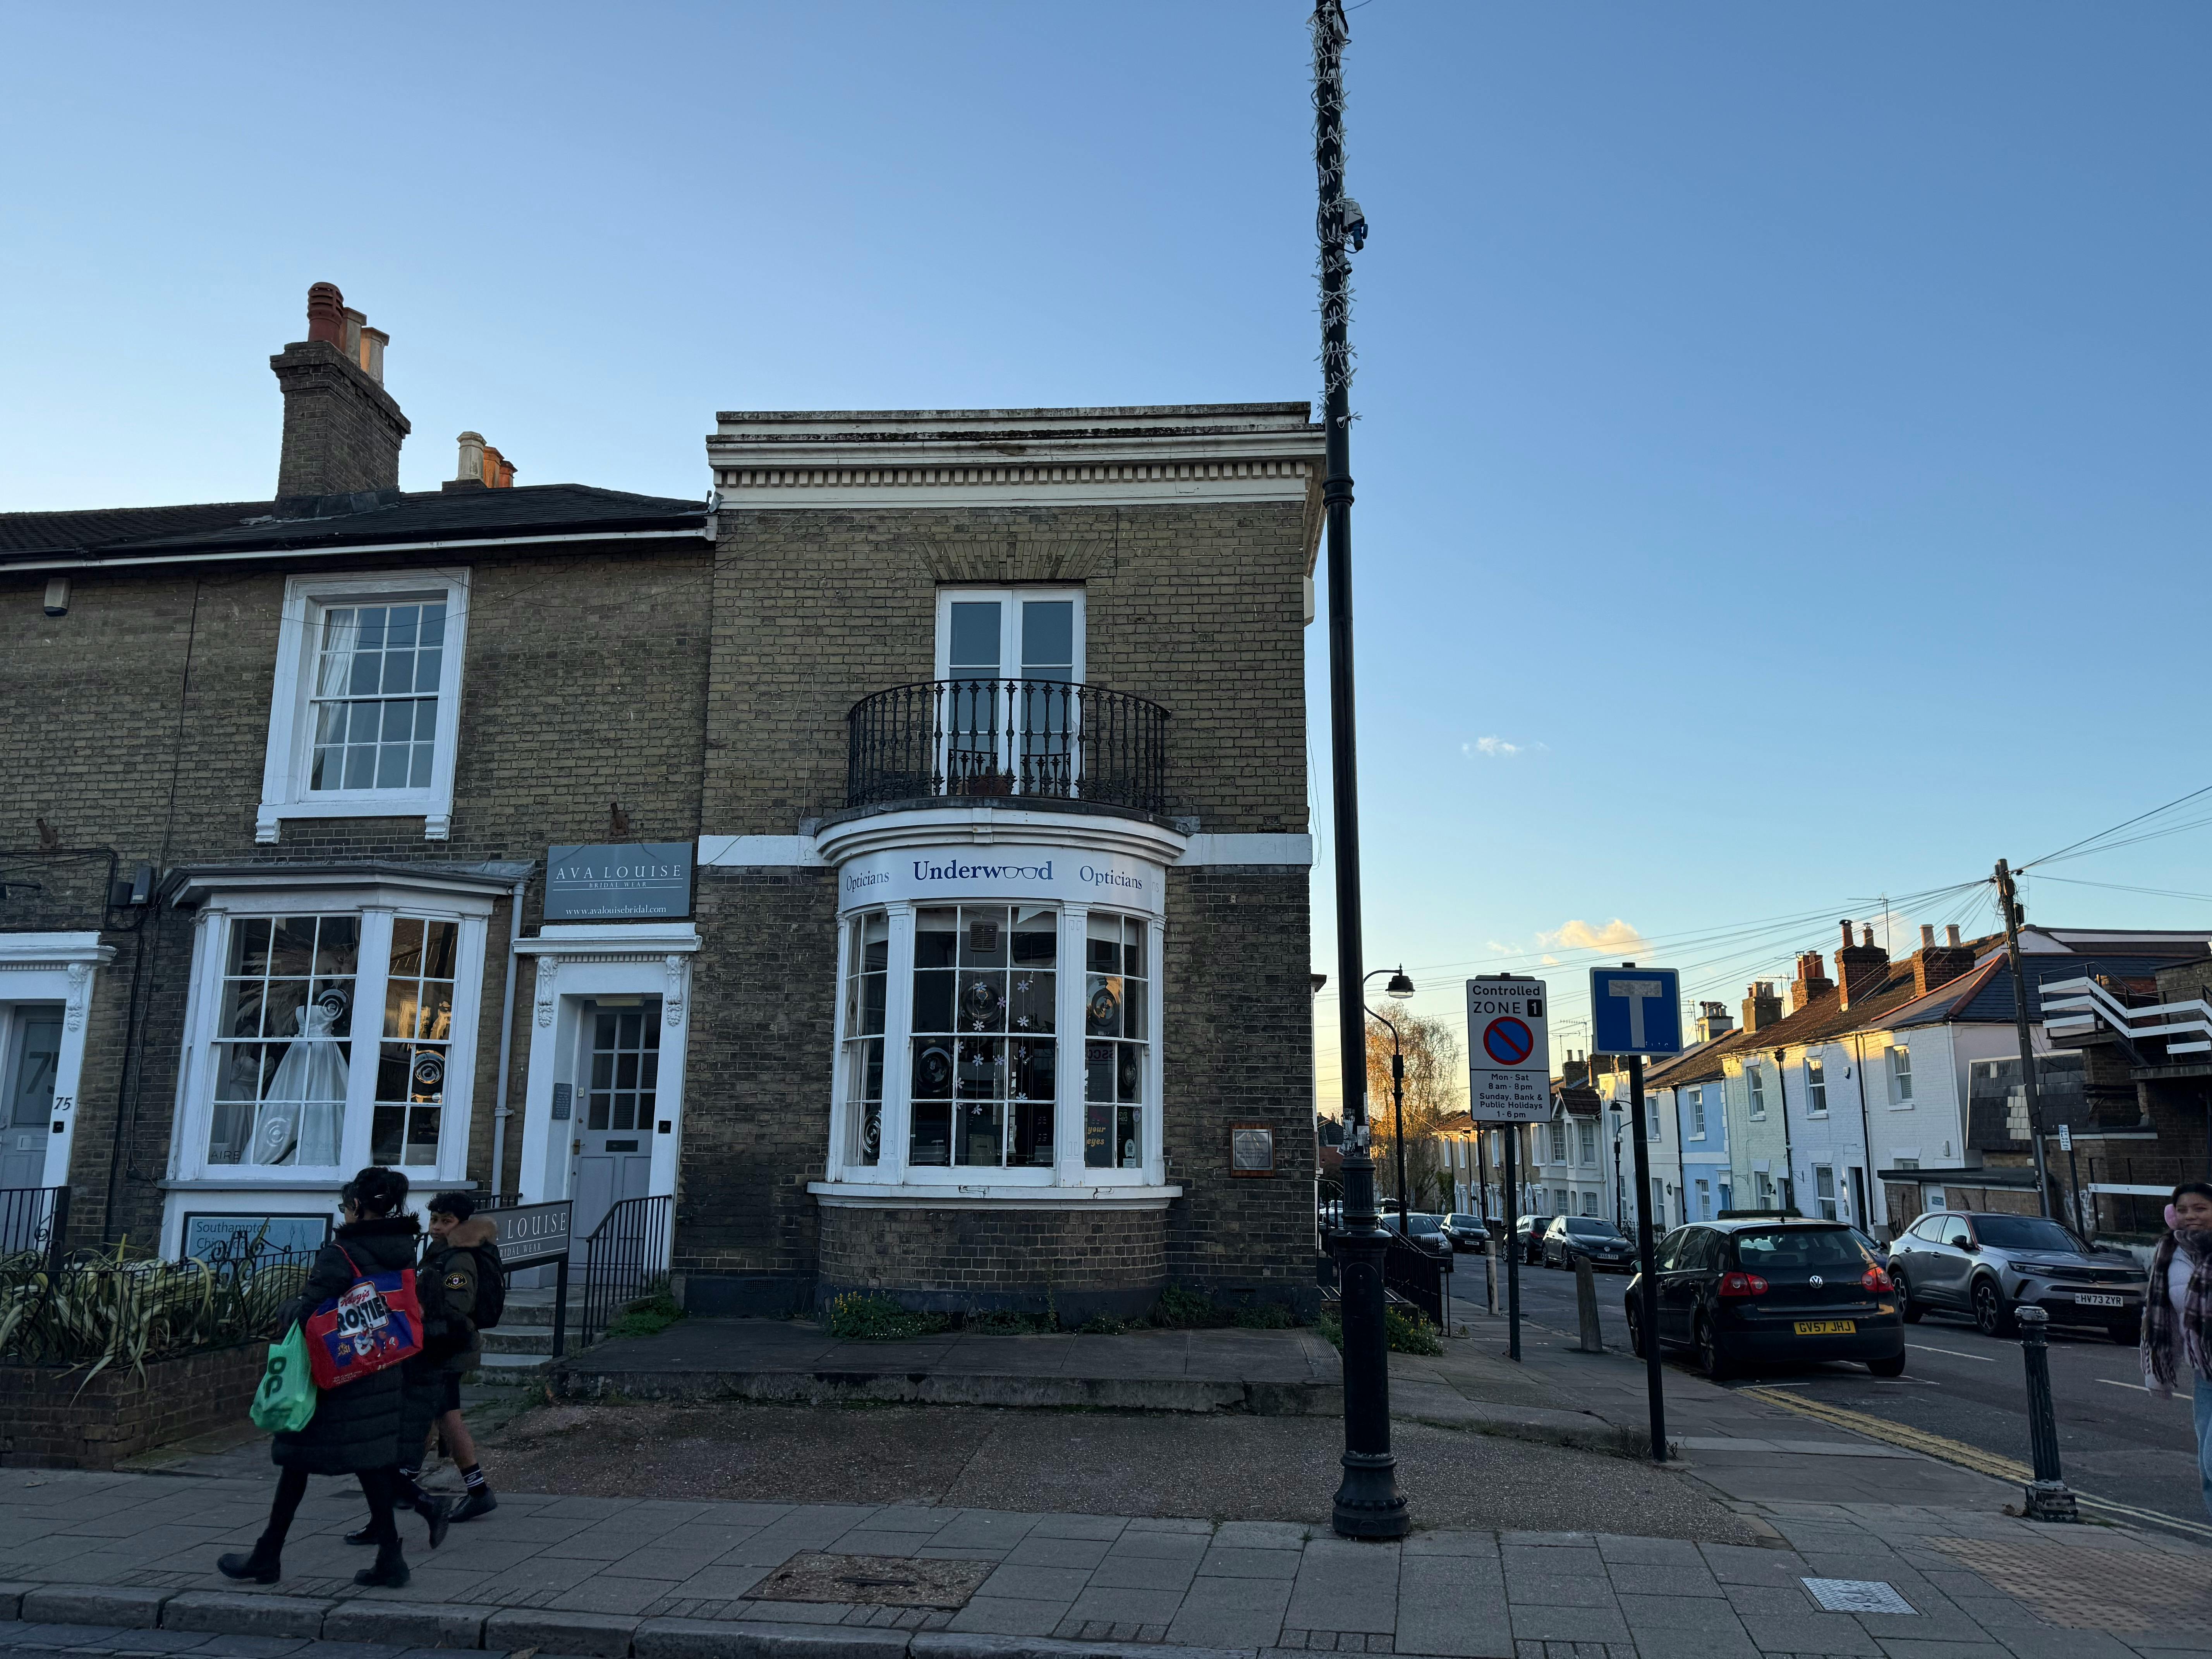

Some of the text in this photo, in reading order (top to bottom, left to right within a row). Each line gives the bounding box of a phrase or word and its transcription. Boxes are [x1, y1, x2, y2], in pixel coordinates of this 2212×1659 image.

[556, 865, 681, 879] AVA LOUISE
[847, 870, 889, 892] Opticians
[1080, 865, 1142, 890] Opticians
[566, 905, 666, 915] www.avalouisebridal.com
[1472, 985, 1540, 996] Controlled
[1473, 1001, 1537, 1015] ZONE 1
[54, 1097, 73, 1111] 75
[1087, 1127, 1106, 1135] your
[1087, 1138, 1105, 1147] eyes
[211, 1151, 241, 1161] AIRE
[507, 1213, 566, 1239] LOUISE
[500, 1243, 541, 1258] RIDAL WEAR
[2081, 1295, 2103, 1304] HV73
[2105, 1296, 2121, 1305] ZYR
[1799, 1321, 1851, 1332] GV57 JHJ
